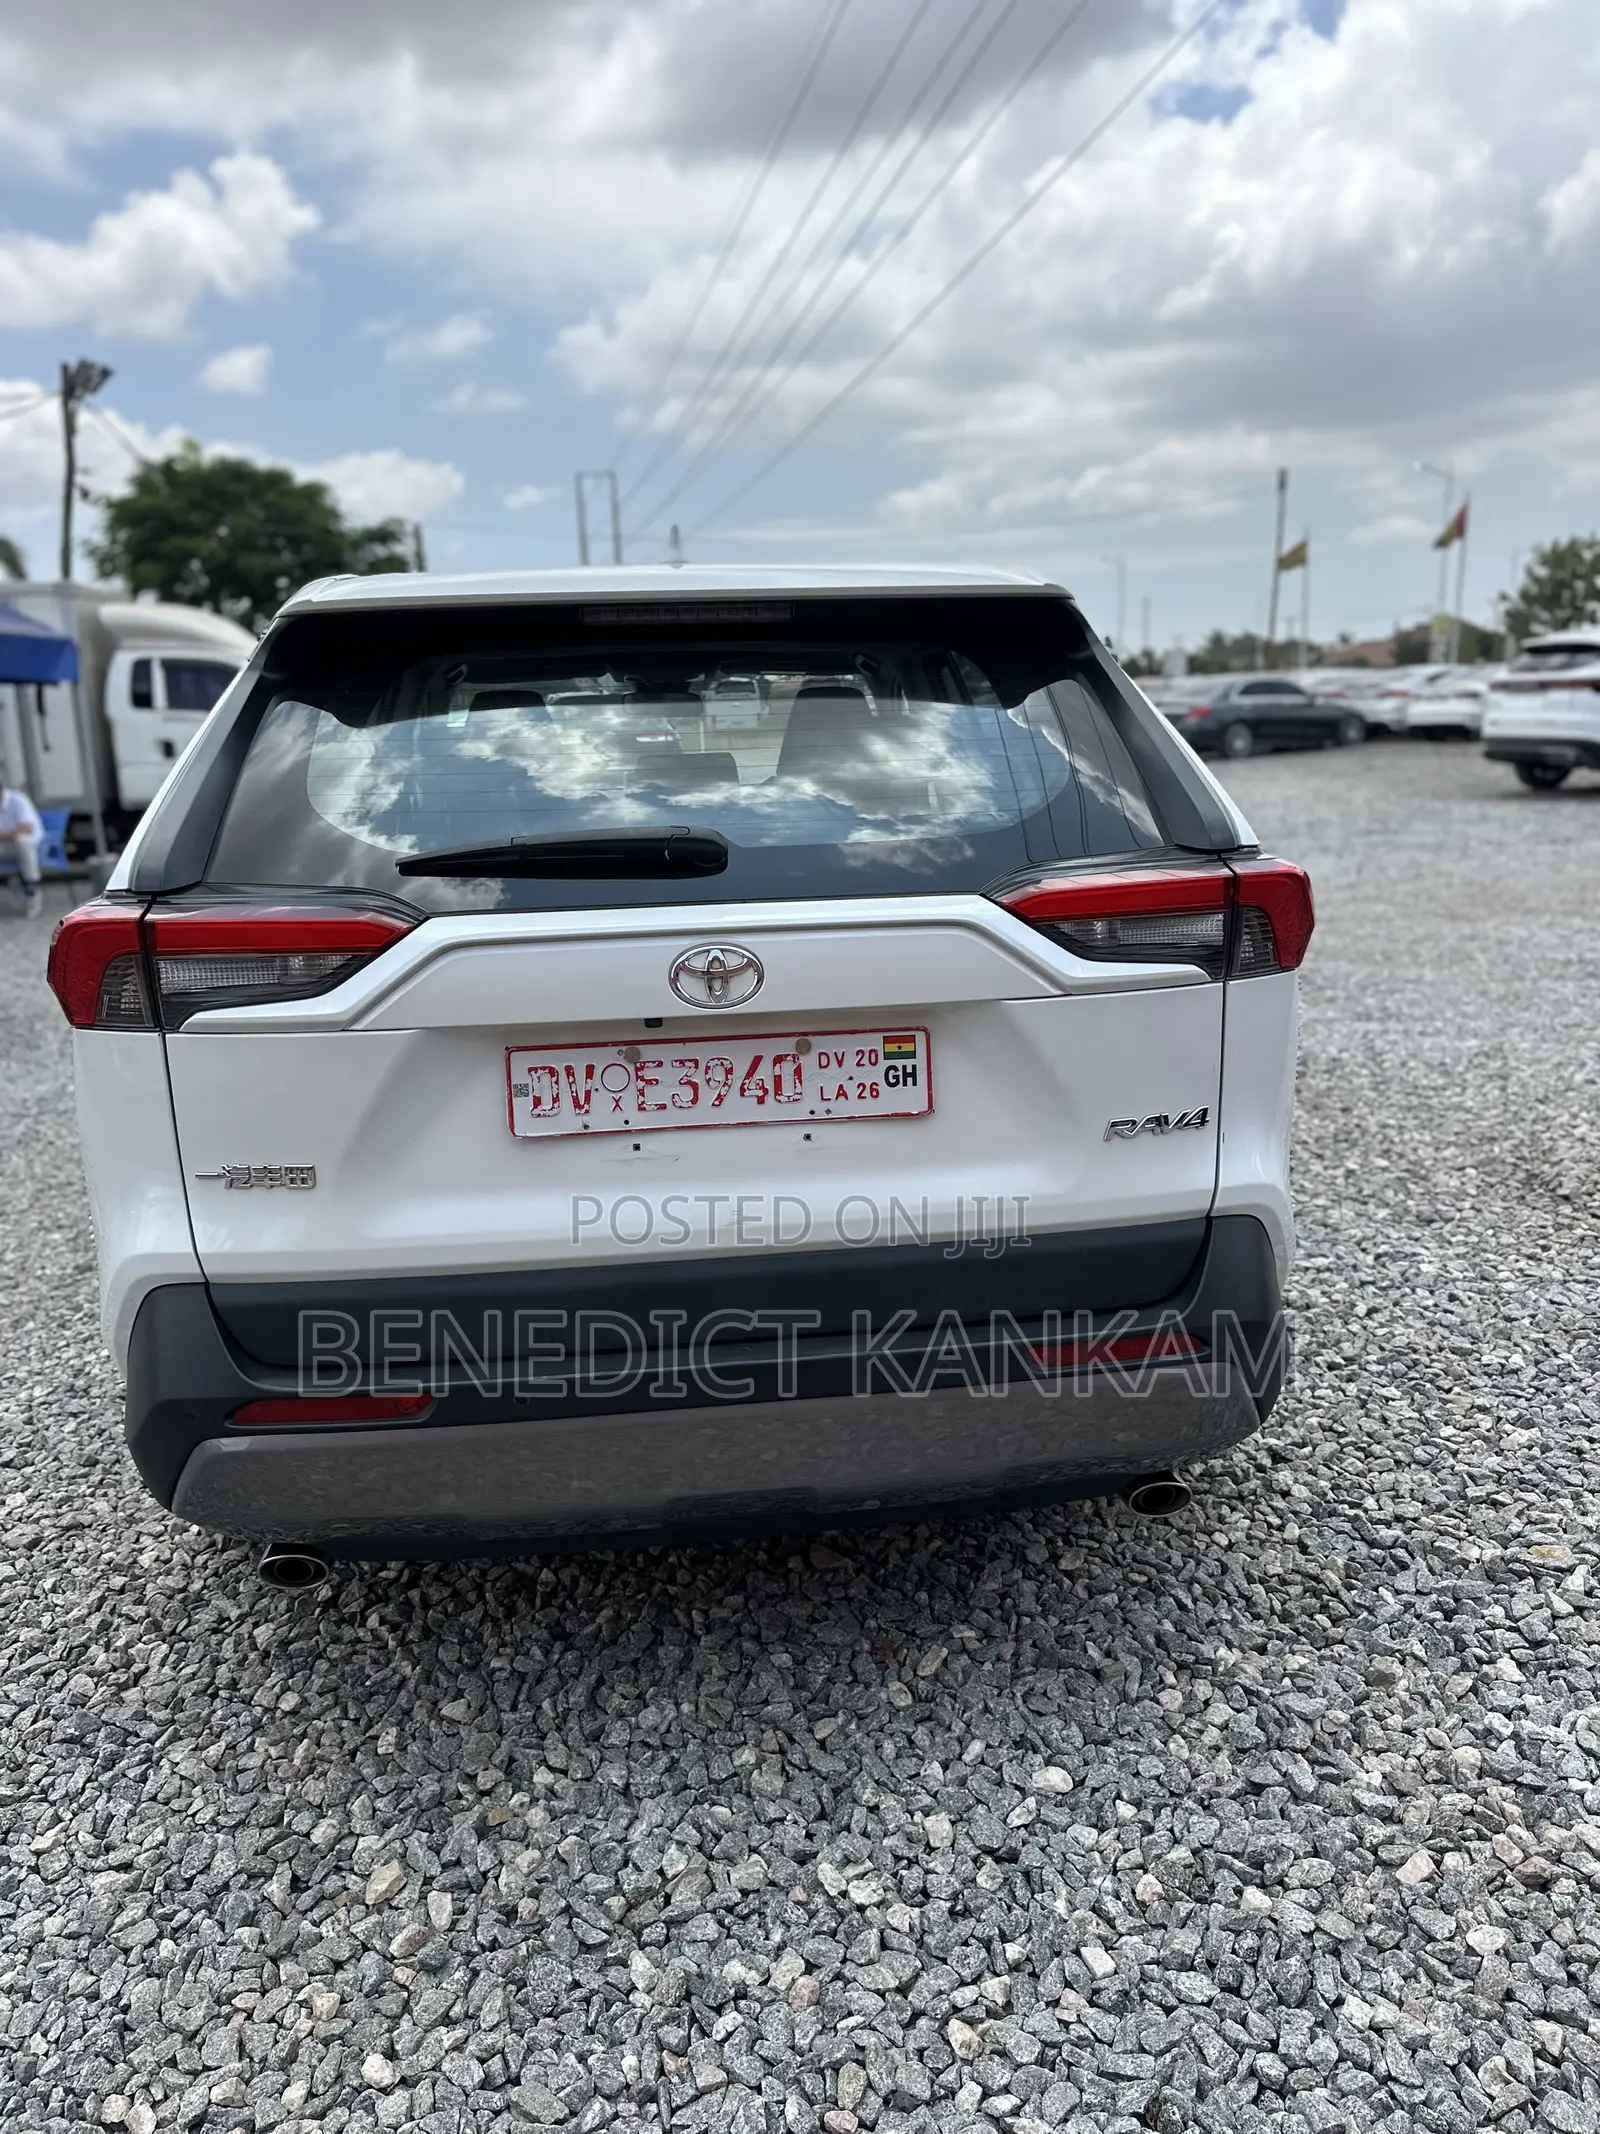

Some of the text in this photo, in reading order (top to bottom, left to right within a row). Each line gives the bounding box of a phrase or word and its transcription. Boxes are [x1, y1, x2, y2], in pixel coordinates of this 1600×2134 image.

[817, 1048, 879, 1069] DV 20
[527, 1053, 804, 1118] DV E3940
[883, 1064, 918, 1088] GH
[819, 1081, 880, 1102] LA 26
[1103, 1105, 1210, 1142] RAV4
